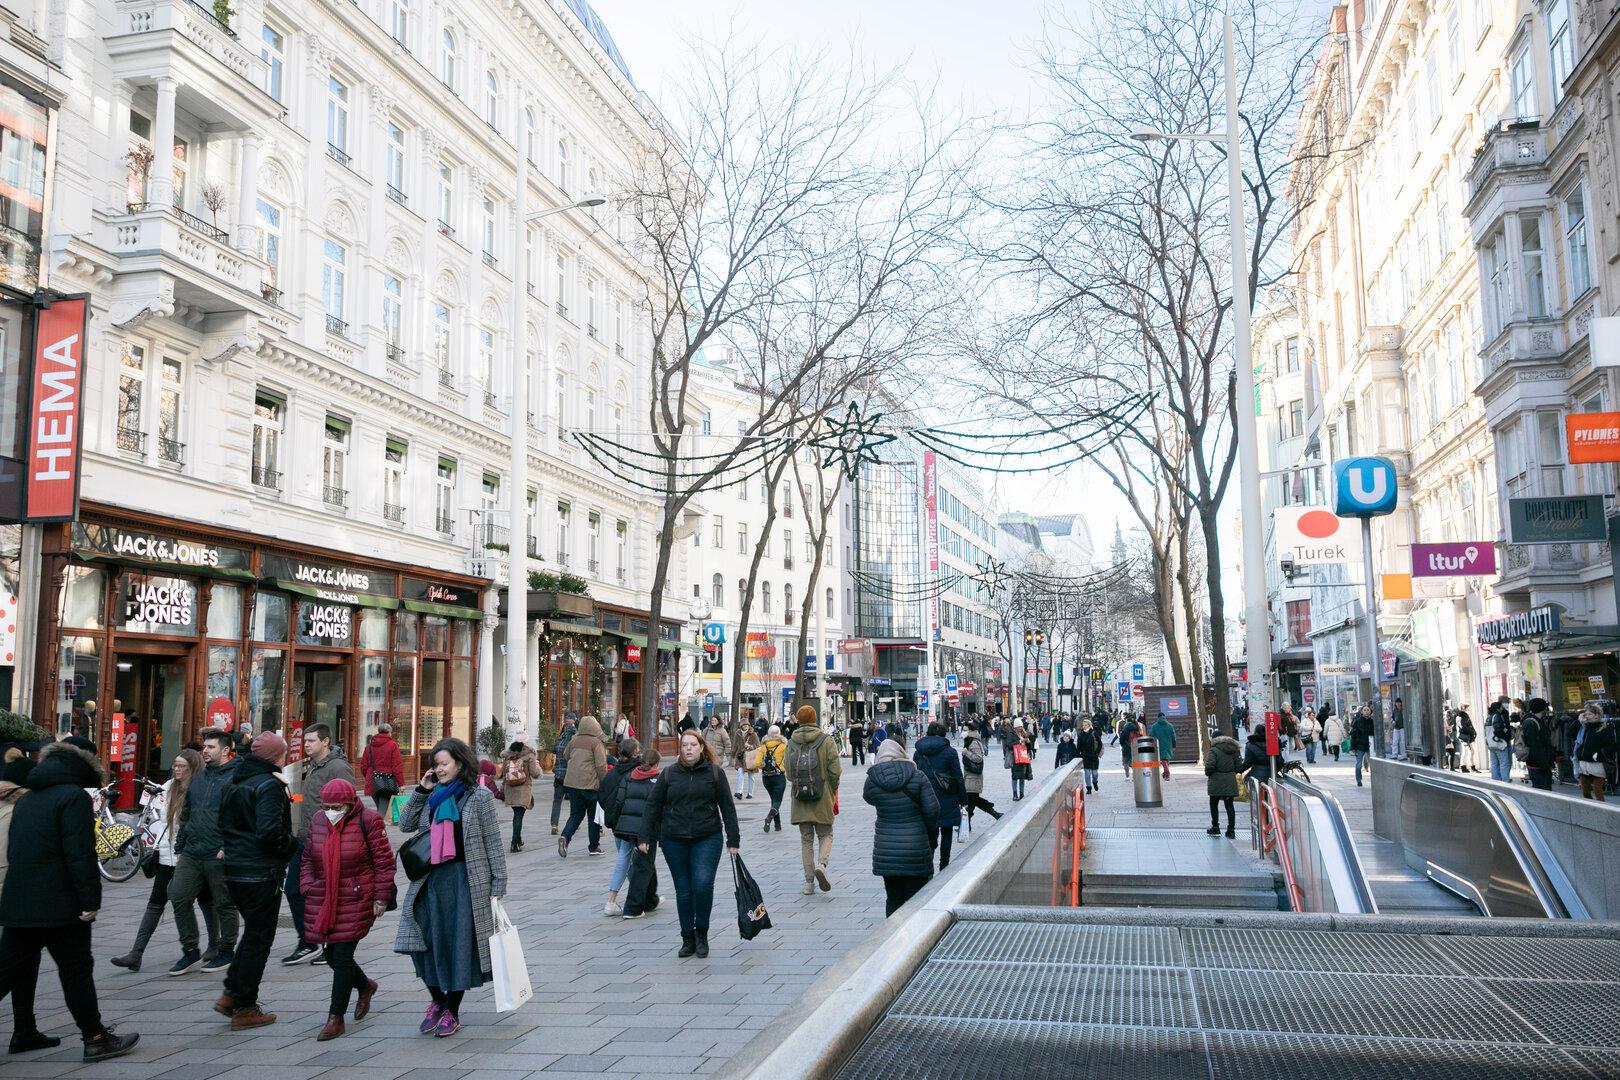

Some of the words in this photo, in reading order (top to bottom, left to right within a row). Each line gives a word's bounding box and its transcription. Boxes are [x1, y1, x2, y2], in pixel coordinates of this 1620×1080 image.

[35, 333, 79, 481] HEMA
[1574, 428, 1619, 441] PYLONES
[1350, 467, 1387, 504] U
[113, 535, 219, 566] JACK&JONES
[1294, 545, 1346, 560] Turek
[1429, 552, 1466, 571] ltur
[296, 565, 369, 590] JACK&JONES
[136, 584, 191, 607] JACK&
[134, 603, 191, 625] JONES
[310, 606, 350, 624] JACK&
[1500, 607, 1552, 639] BORTOLOTTI
[309, 621, 348, 639] JONES
[708, 627, 720, 641] U
